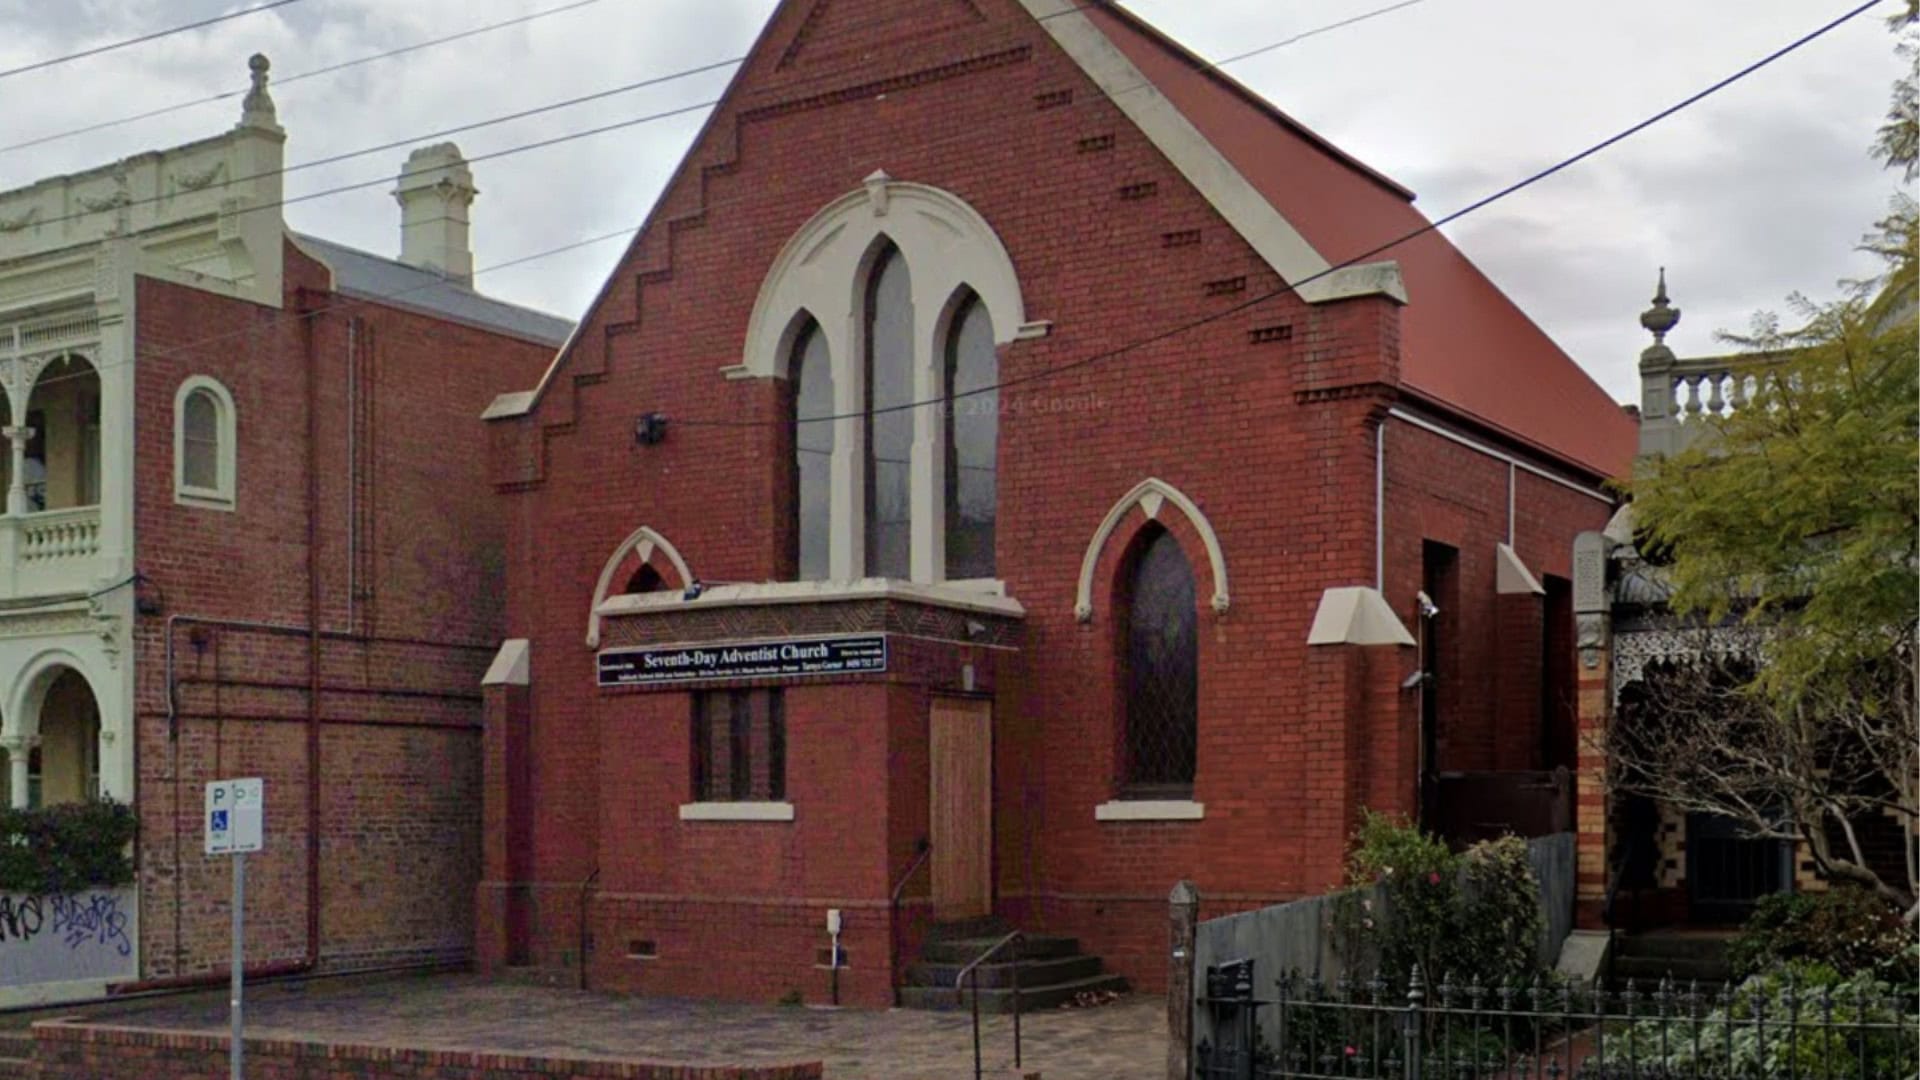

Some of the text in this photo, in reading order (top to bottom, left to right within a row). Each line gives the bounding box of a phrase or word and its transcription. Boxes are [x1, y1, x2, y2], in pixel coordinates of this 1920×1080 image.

[643, 650, 719, 668] Seventh-Day
[720, 645, 779, 664] Adventist
[780, 643, 829, 659] Church
[213, 787, 226, 805] P
